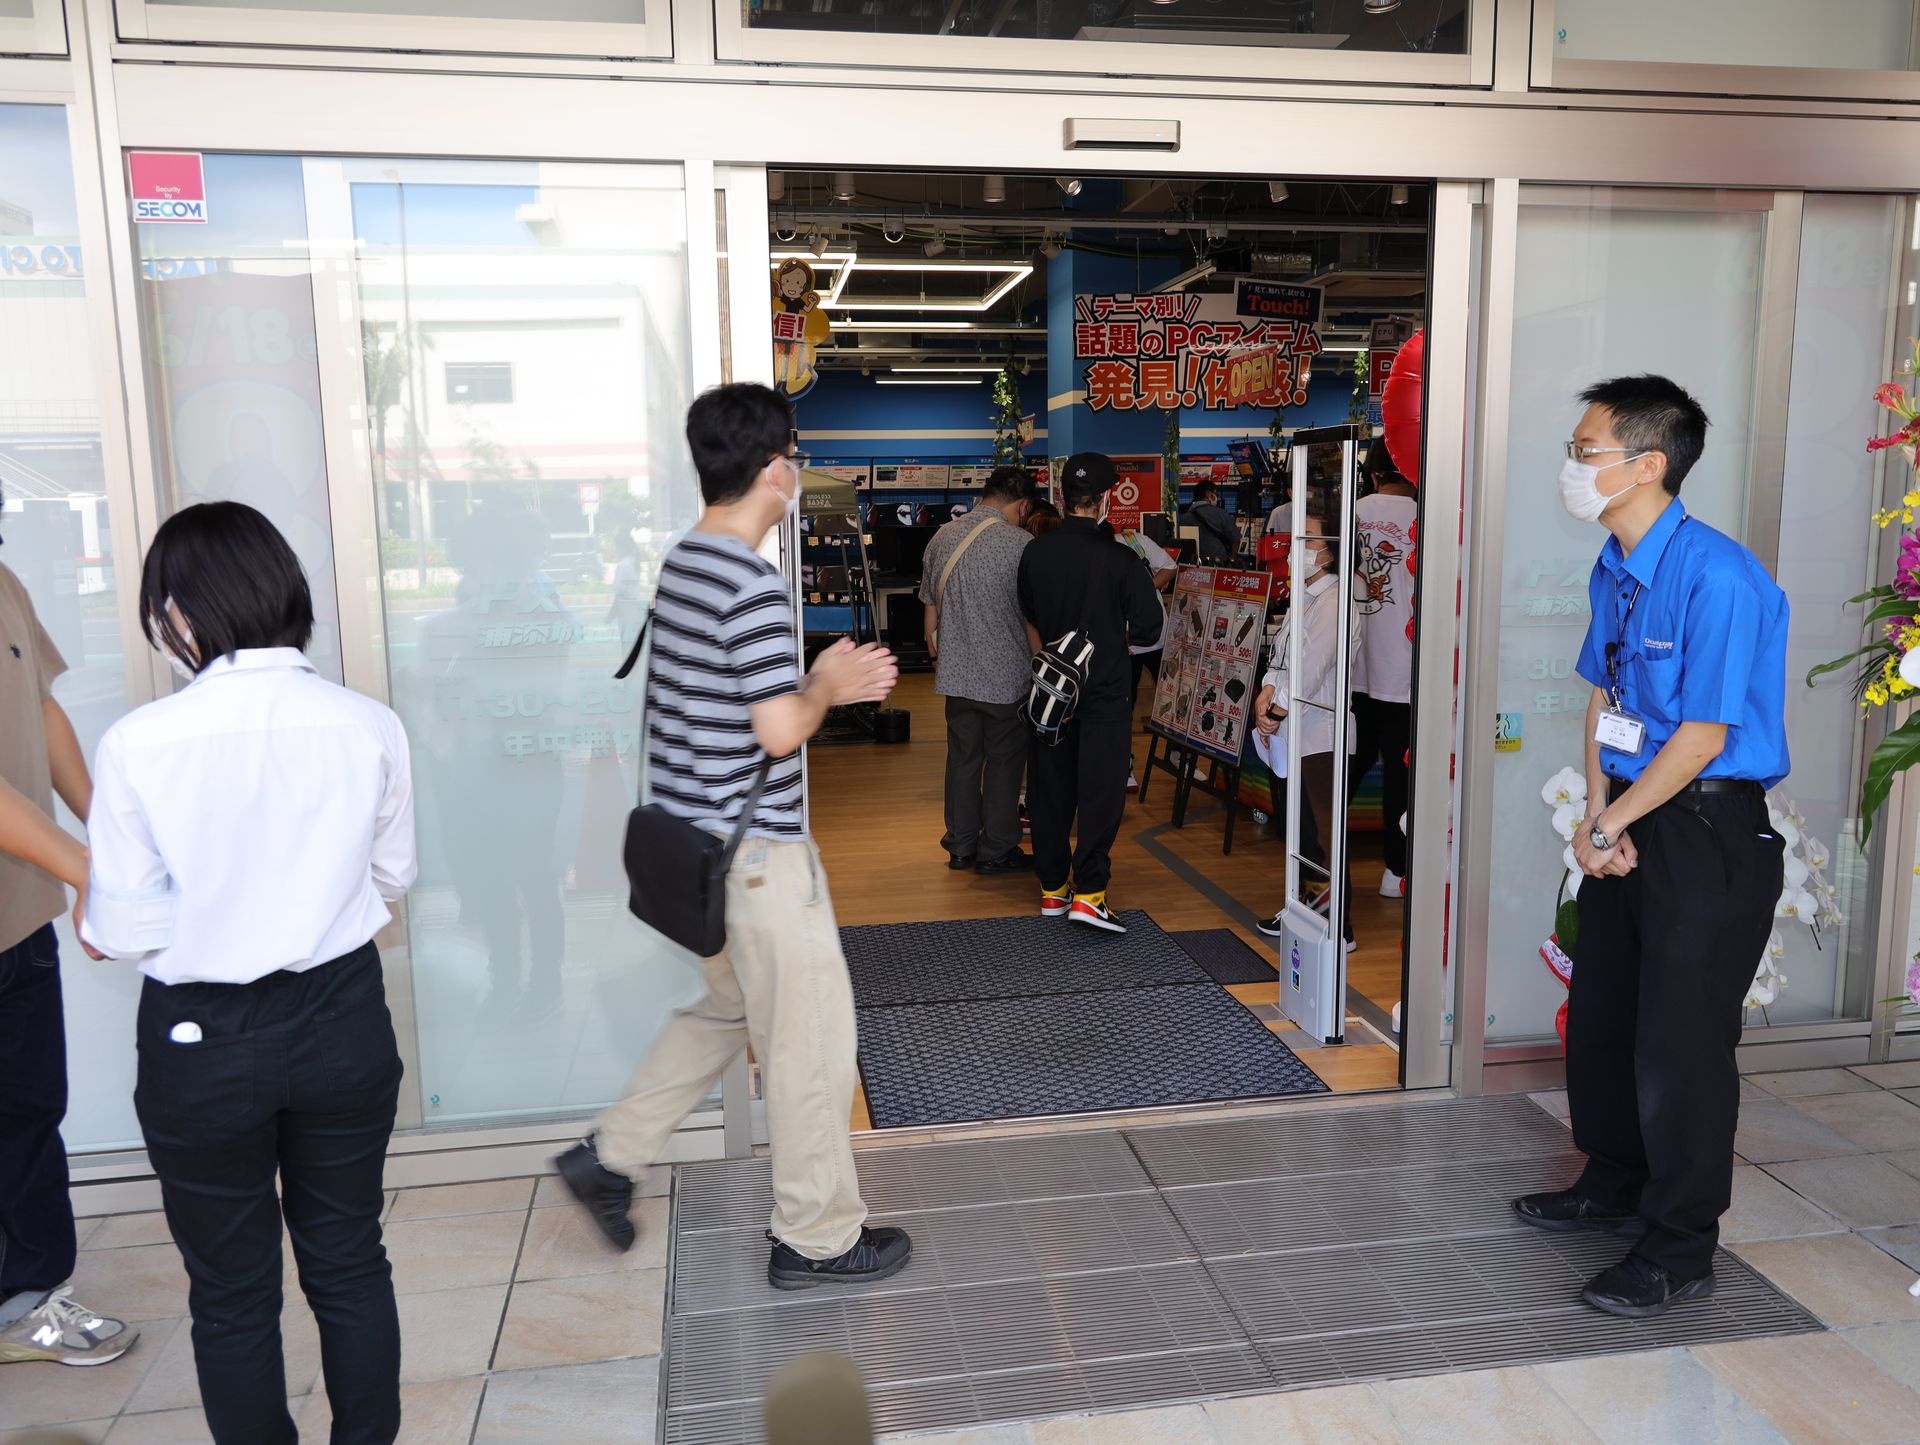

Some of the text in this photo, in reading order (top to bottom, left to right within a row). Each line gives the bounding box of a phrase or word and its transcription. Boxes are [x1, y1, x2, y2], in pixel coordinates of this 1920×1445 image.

[155, 185, 181, 194] Security
[137, 201, 202, 218] SECOM
[1247, 294, 1310, 317] Touch!
[1075, 322, 1322, 358] 話題のPCアイテム
[1377, 328, 1393, 336] CPU
[1230, 356, 1275, 398] OPEN
